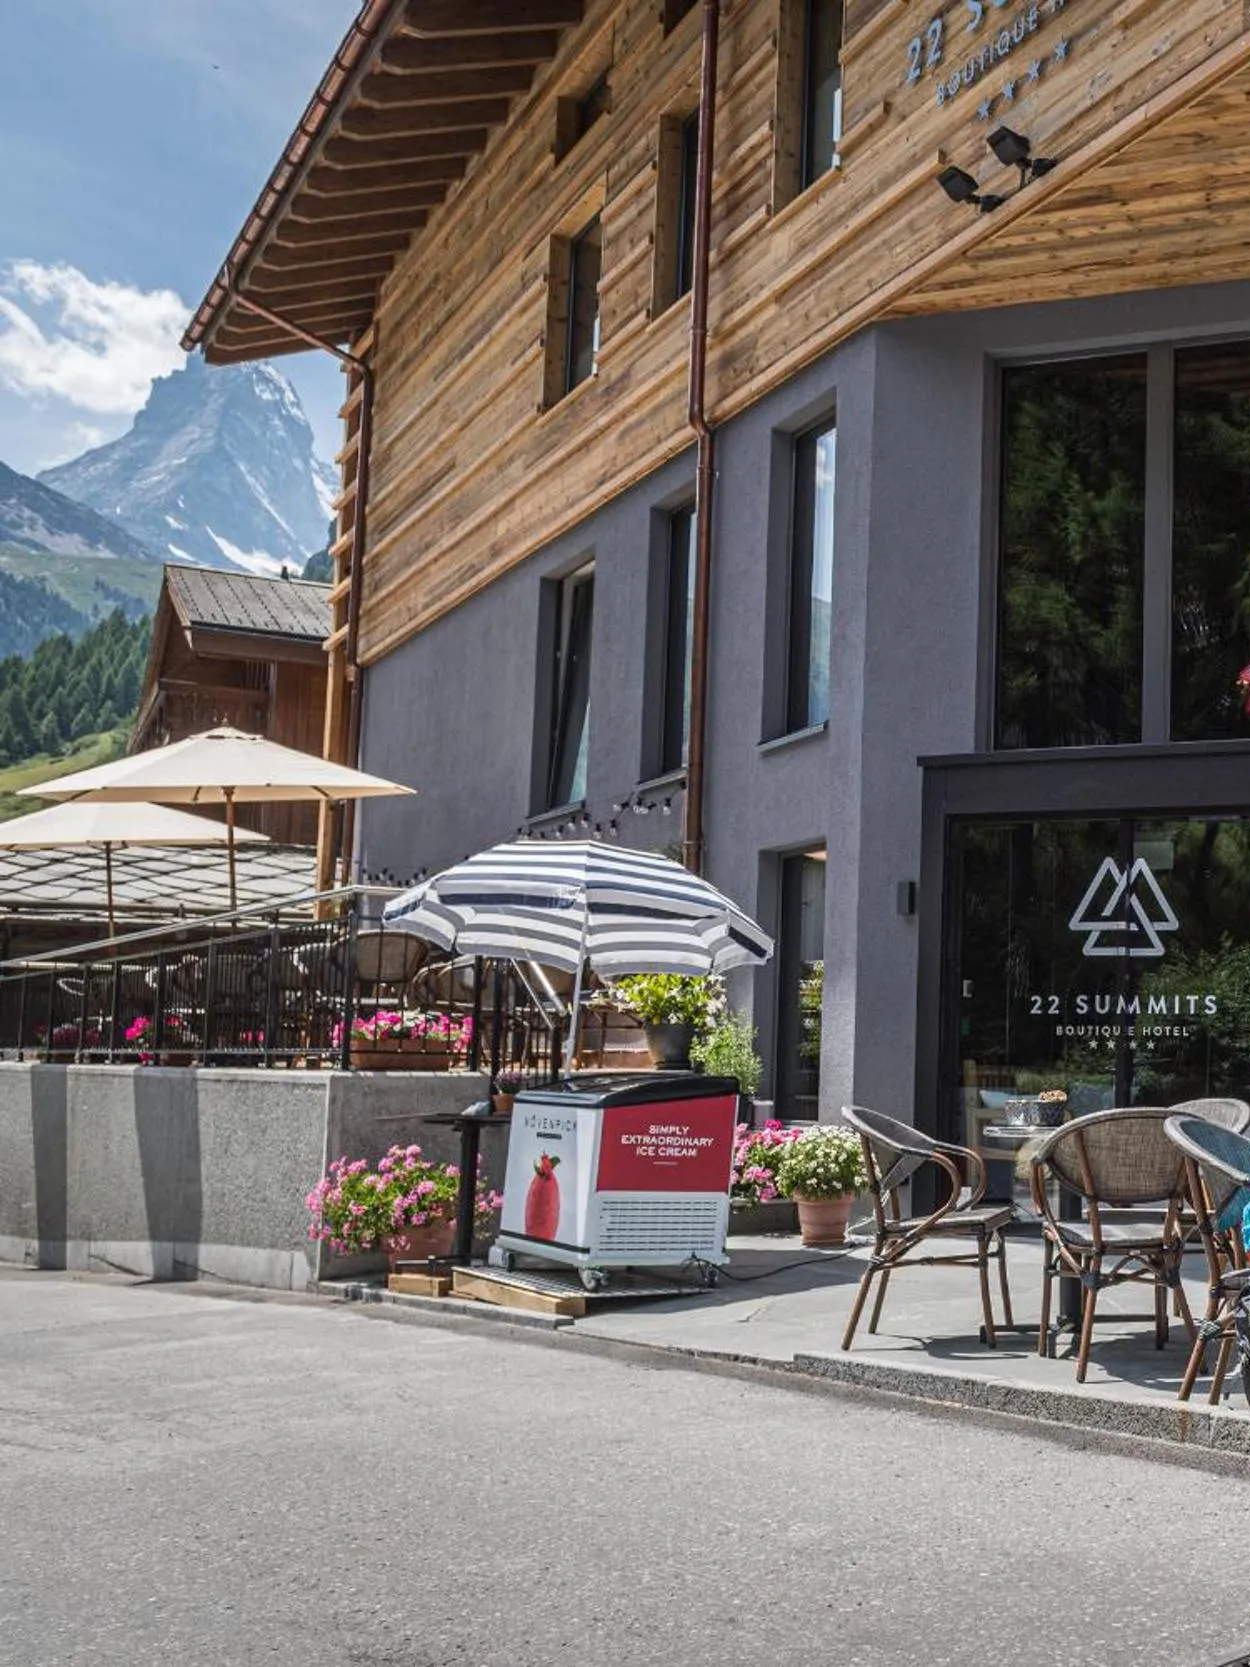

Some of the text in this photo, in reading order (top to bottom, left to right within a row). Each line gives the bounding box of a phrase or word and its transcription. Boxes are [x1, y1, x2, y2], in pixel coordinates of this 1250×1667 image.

[906, 18, 943, 85] 22
[936, 6, 1040, 106] BOUTIQUE
[1029, 995, 1218, 1015] 22 SUMMITS
[1055, 1025, 1190, 1037] BOUTIQUE HOTEL
[648, 1124, 690, 1135] SIMPLY
[620, 1135, 715, 1147] EXTRAORDINARY
[636, 1146, 697, 1157] ICE CREAM
